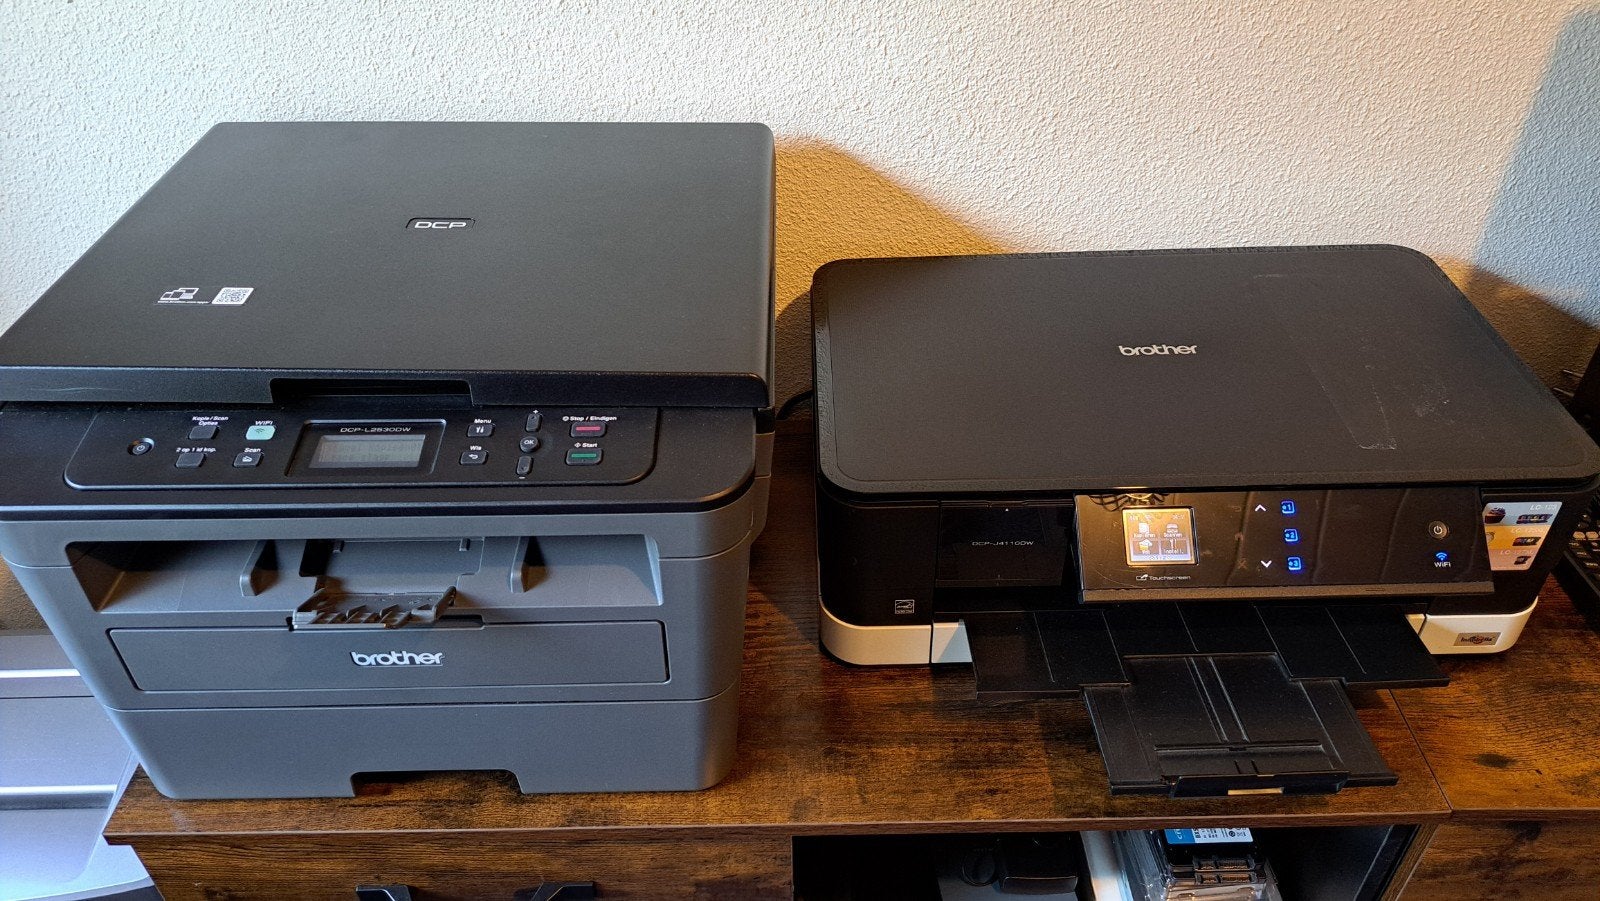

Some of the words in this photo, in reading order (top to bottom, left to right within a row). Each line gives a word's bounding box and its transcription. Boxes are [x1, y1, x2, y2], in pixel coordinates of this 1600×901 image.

[413, 221, 467, 229] DCP
[1118, 344, 1198, 356] brother
[351, 650, 443, 666] brother
